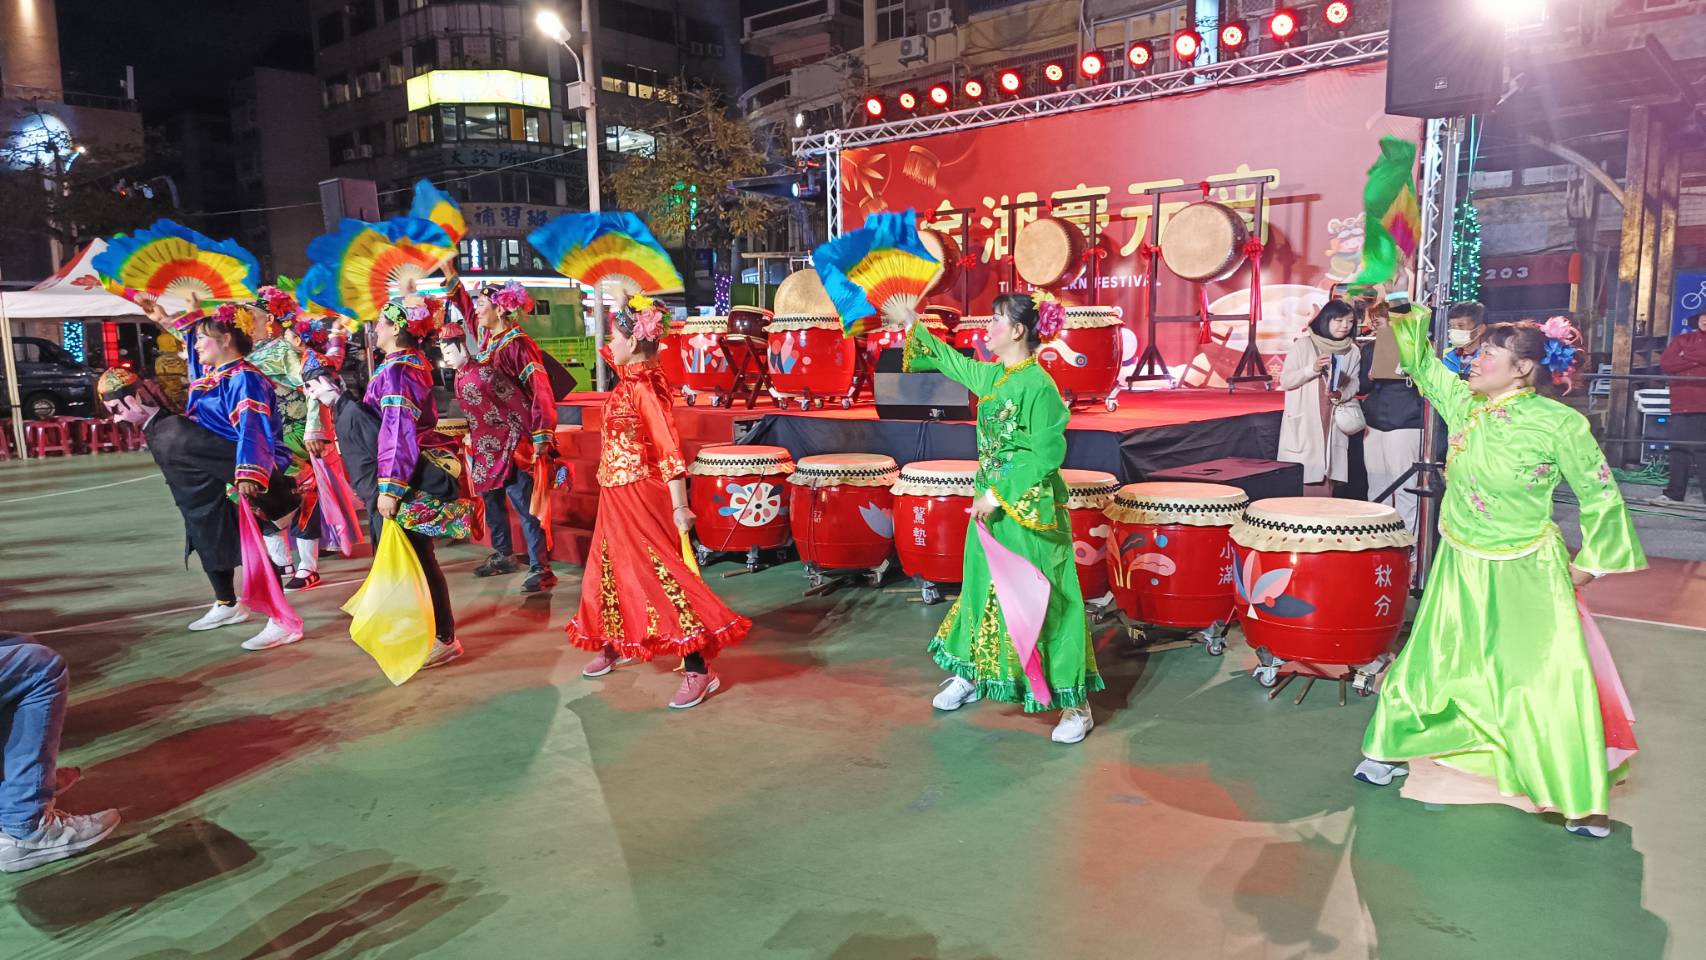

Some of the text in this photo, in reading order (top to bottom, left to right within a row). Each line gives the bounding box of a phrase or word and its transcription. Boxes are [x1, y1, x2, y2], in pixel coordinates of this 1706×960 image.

[474, 206, 549, 228] 補習班
[1094, 274, 1162, 289] FESTIVA
[1484, 266, 1529, 280] 203
[1374, 563, 1392, 617] 秋分
